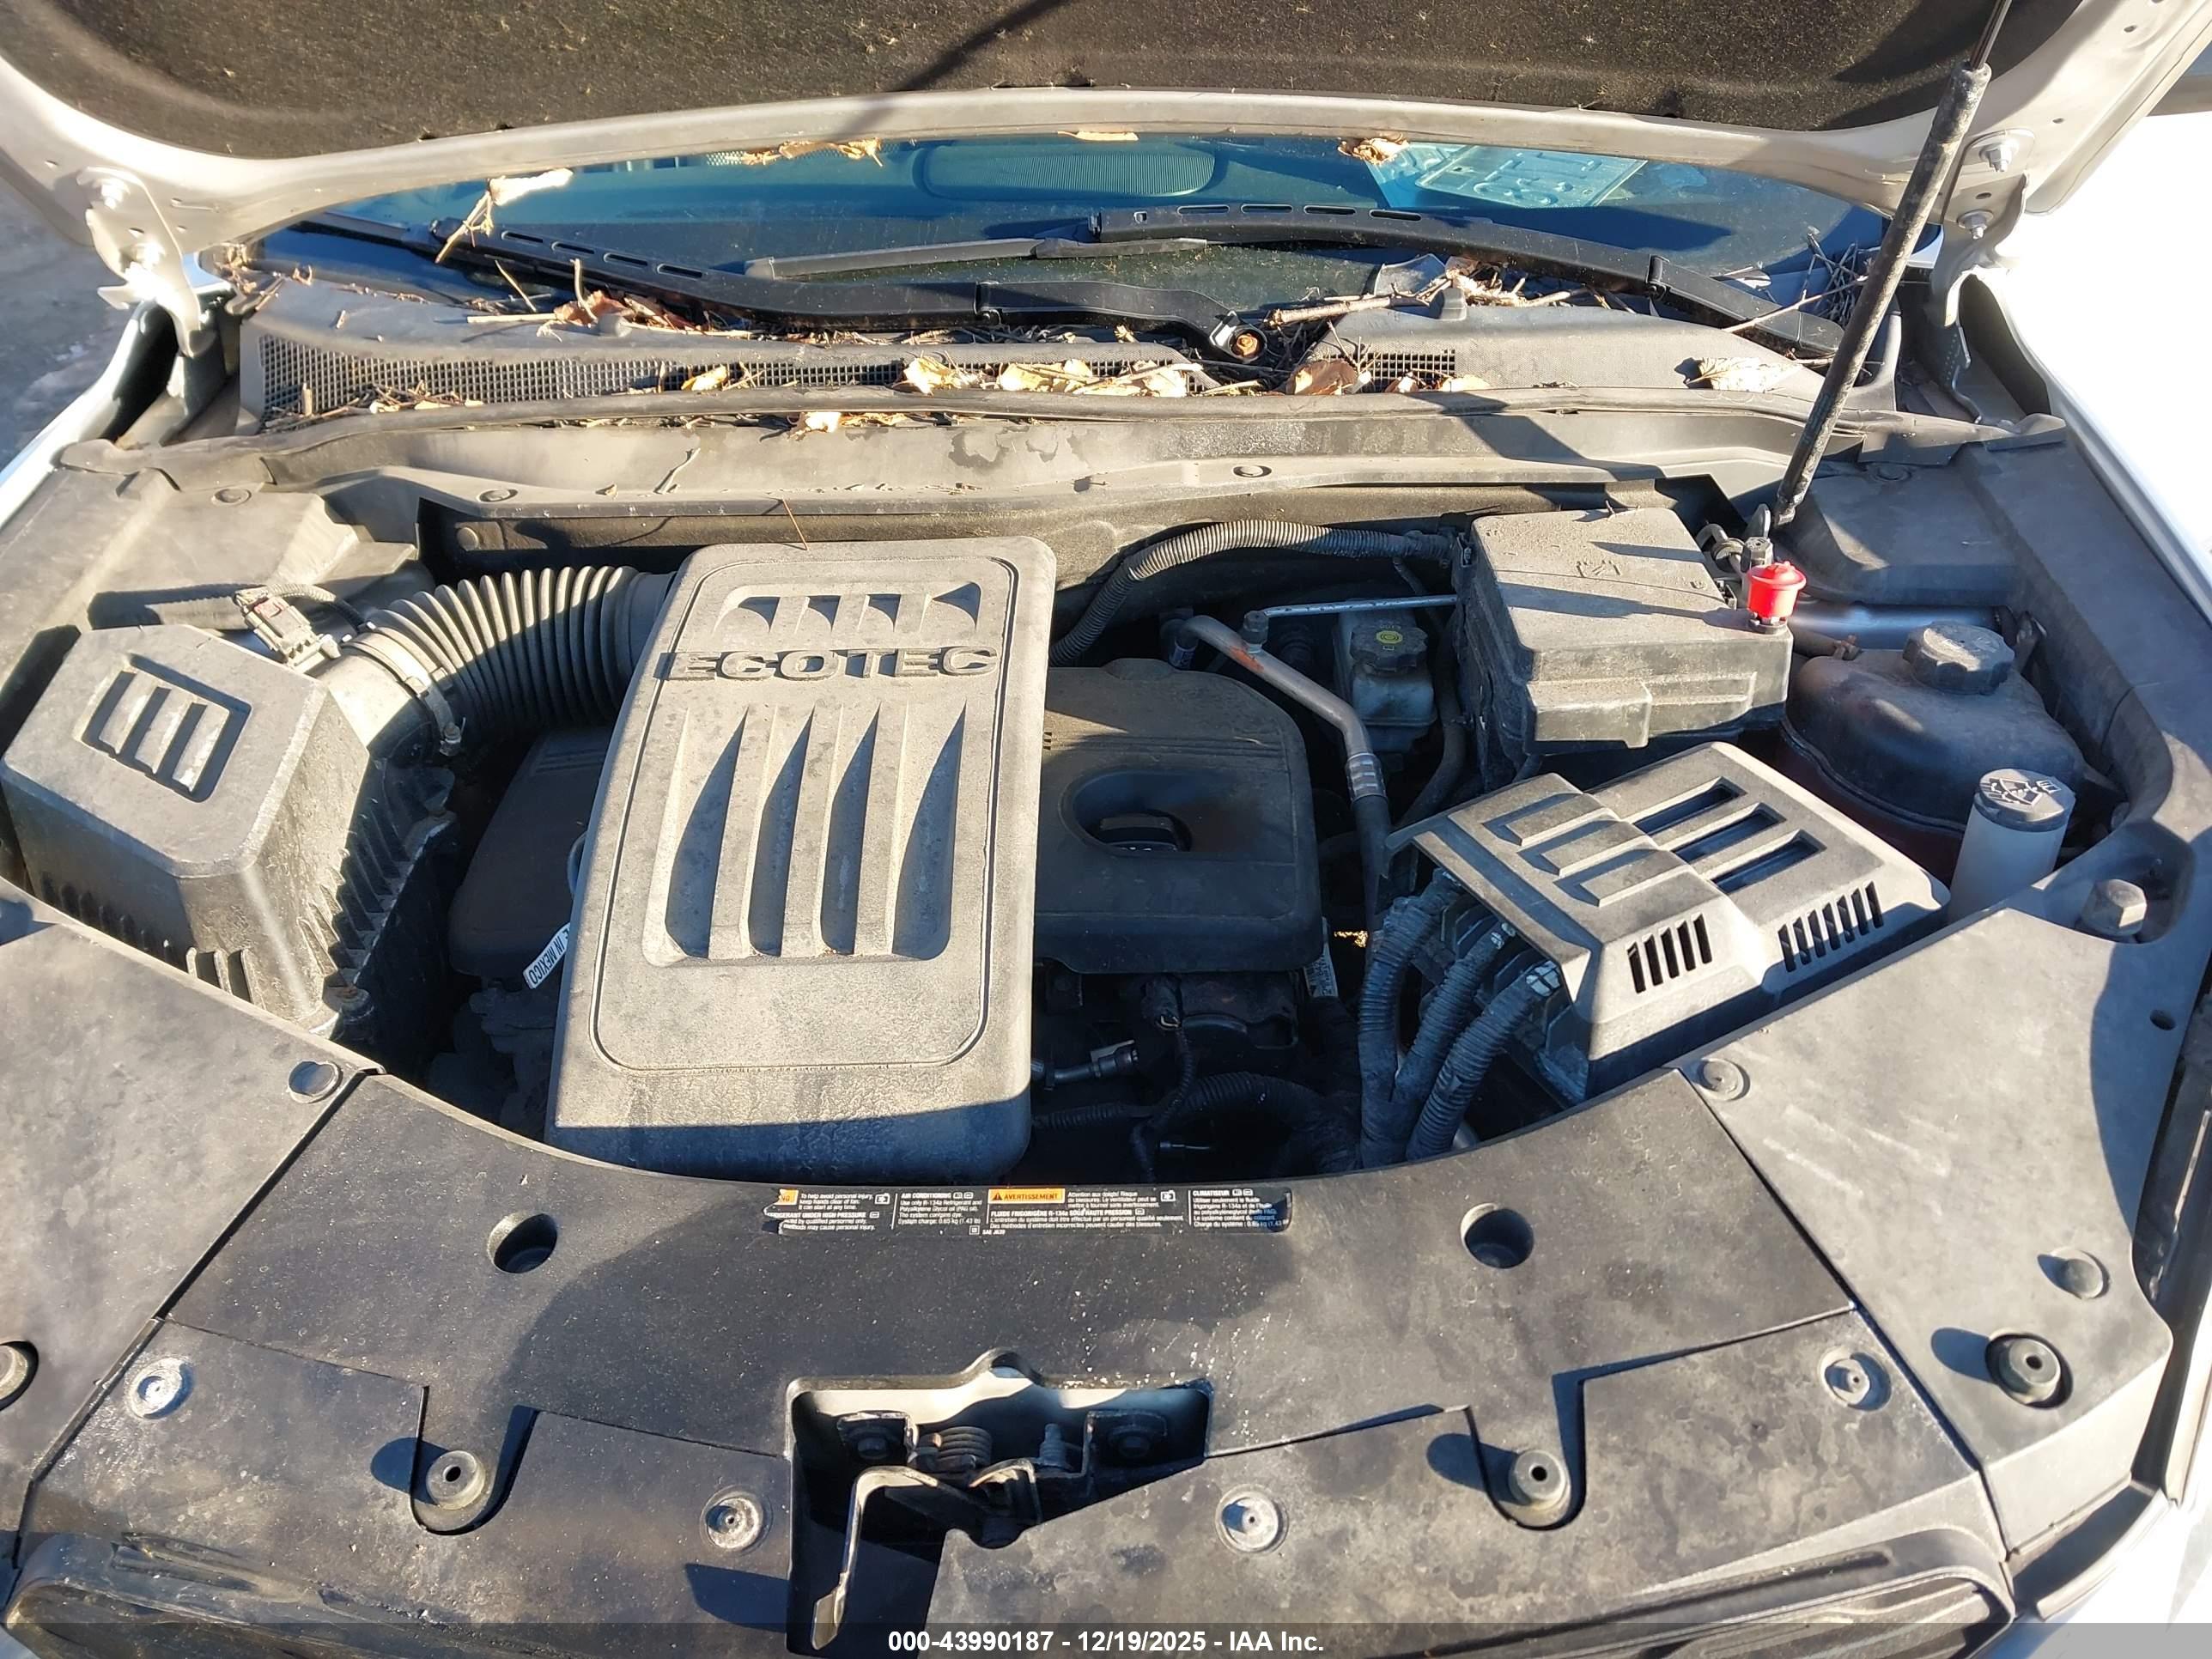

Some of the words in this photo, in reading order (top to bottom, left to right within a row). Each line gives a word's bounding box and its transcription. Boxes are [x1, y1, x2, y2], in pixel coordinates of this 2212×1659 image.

[671, 646, 998, 681] ECOTEC
[553, 935, 565, 955] IN
[528, 945, 557, 985] MEXICO
